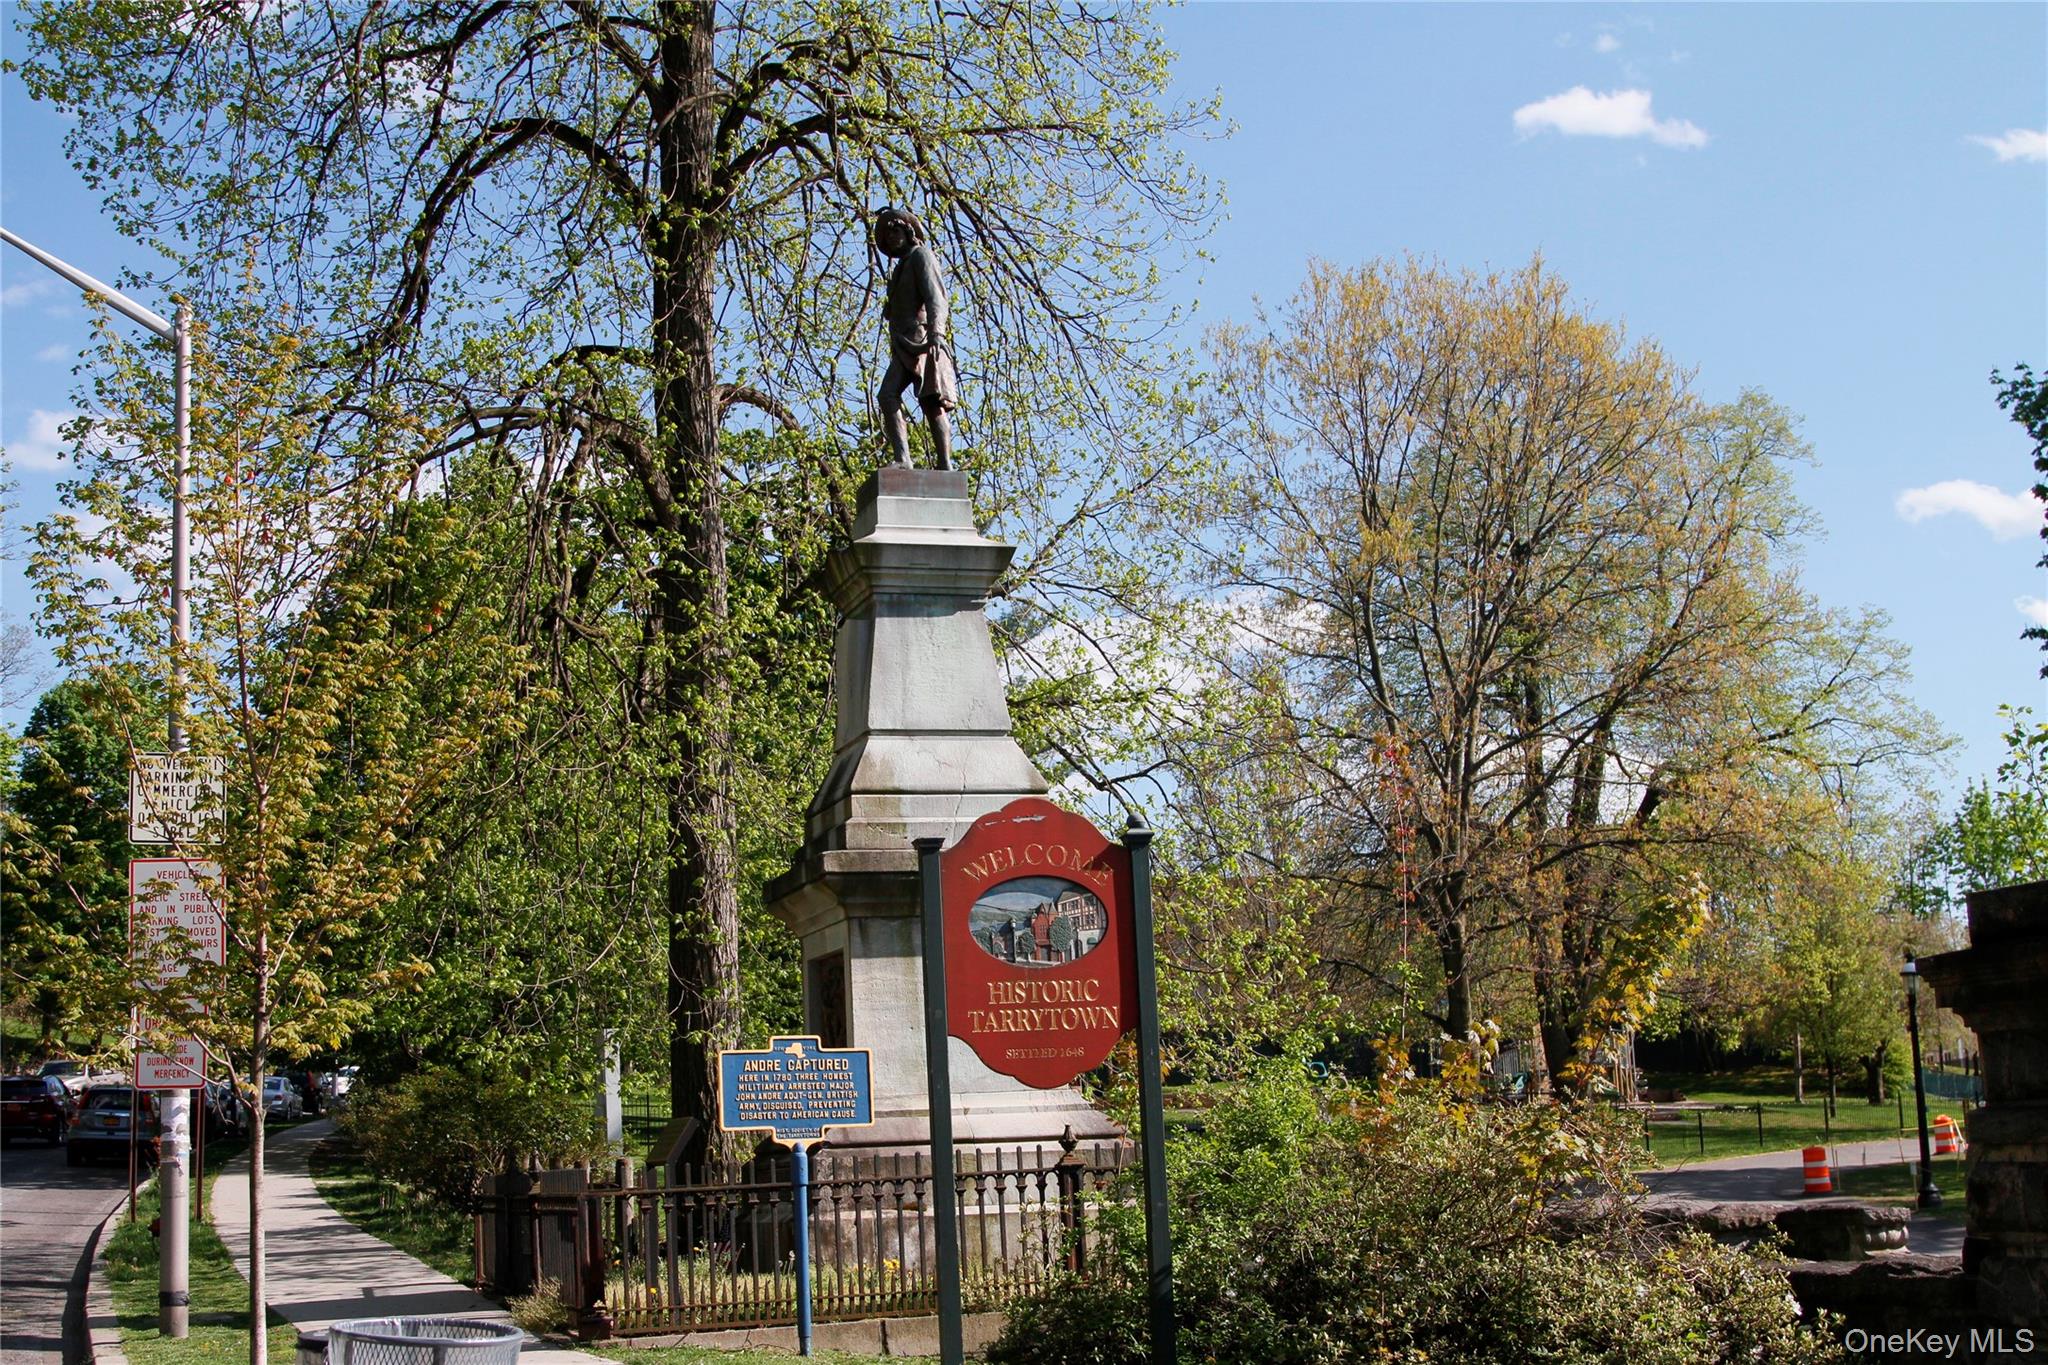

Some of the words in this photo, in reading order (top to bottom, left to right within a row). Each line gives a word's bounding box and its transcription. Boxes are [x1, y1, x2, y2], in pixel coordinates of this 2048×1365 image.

[141, 772, 189, 783] ARKING
[137, 785, 214, 797] CMMERCI
[963, 844, 1114, 886] WELCOME
[180, 892, 217, 902] STREE
[140, 905, 157, 914] AND
[167, 905, 175, 914] IN
[184, 904, 216, 913] PUBLIC
[193, 916, 214, 925] LOTS
[187, 928, 216, 937] MOVED
[987, 979, 1100, 1004] HISTORIC
[967, 1006, 1120, 1033] TARRYTOWN
[1005, 1048, 1058, 1059] SETTLED
[744, 1060, 781, 1072] ANDRE
[788, 1059, 849, 1071] CAPTURED
[738, 1074, 759, 1082] HERE
[773, 1073, 792, 1081] 1780
[822, 1072, 853, 1080] HONEST
[738, 1083, 785, 1091] MILITIAMEN
[788, 1082, 826, 1090] ARRESTED
[830, 1081, 855, 1090] MAJOR
[735, 1092, 756, 1101] JOHN
[758, 1092, 782, 1100] ANDRE
[826, 1090, 859, 1099] BRITISH
[739, 1102, 761, 1111] ARMY,
[808, 1100, 857, 1109] PREVENTING
[740, 1111, 777, 1120] DISASTER
[780, 1111, 790, 1120] TO
[792, 1110, 829, 1119] AMERICAN
